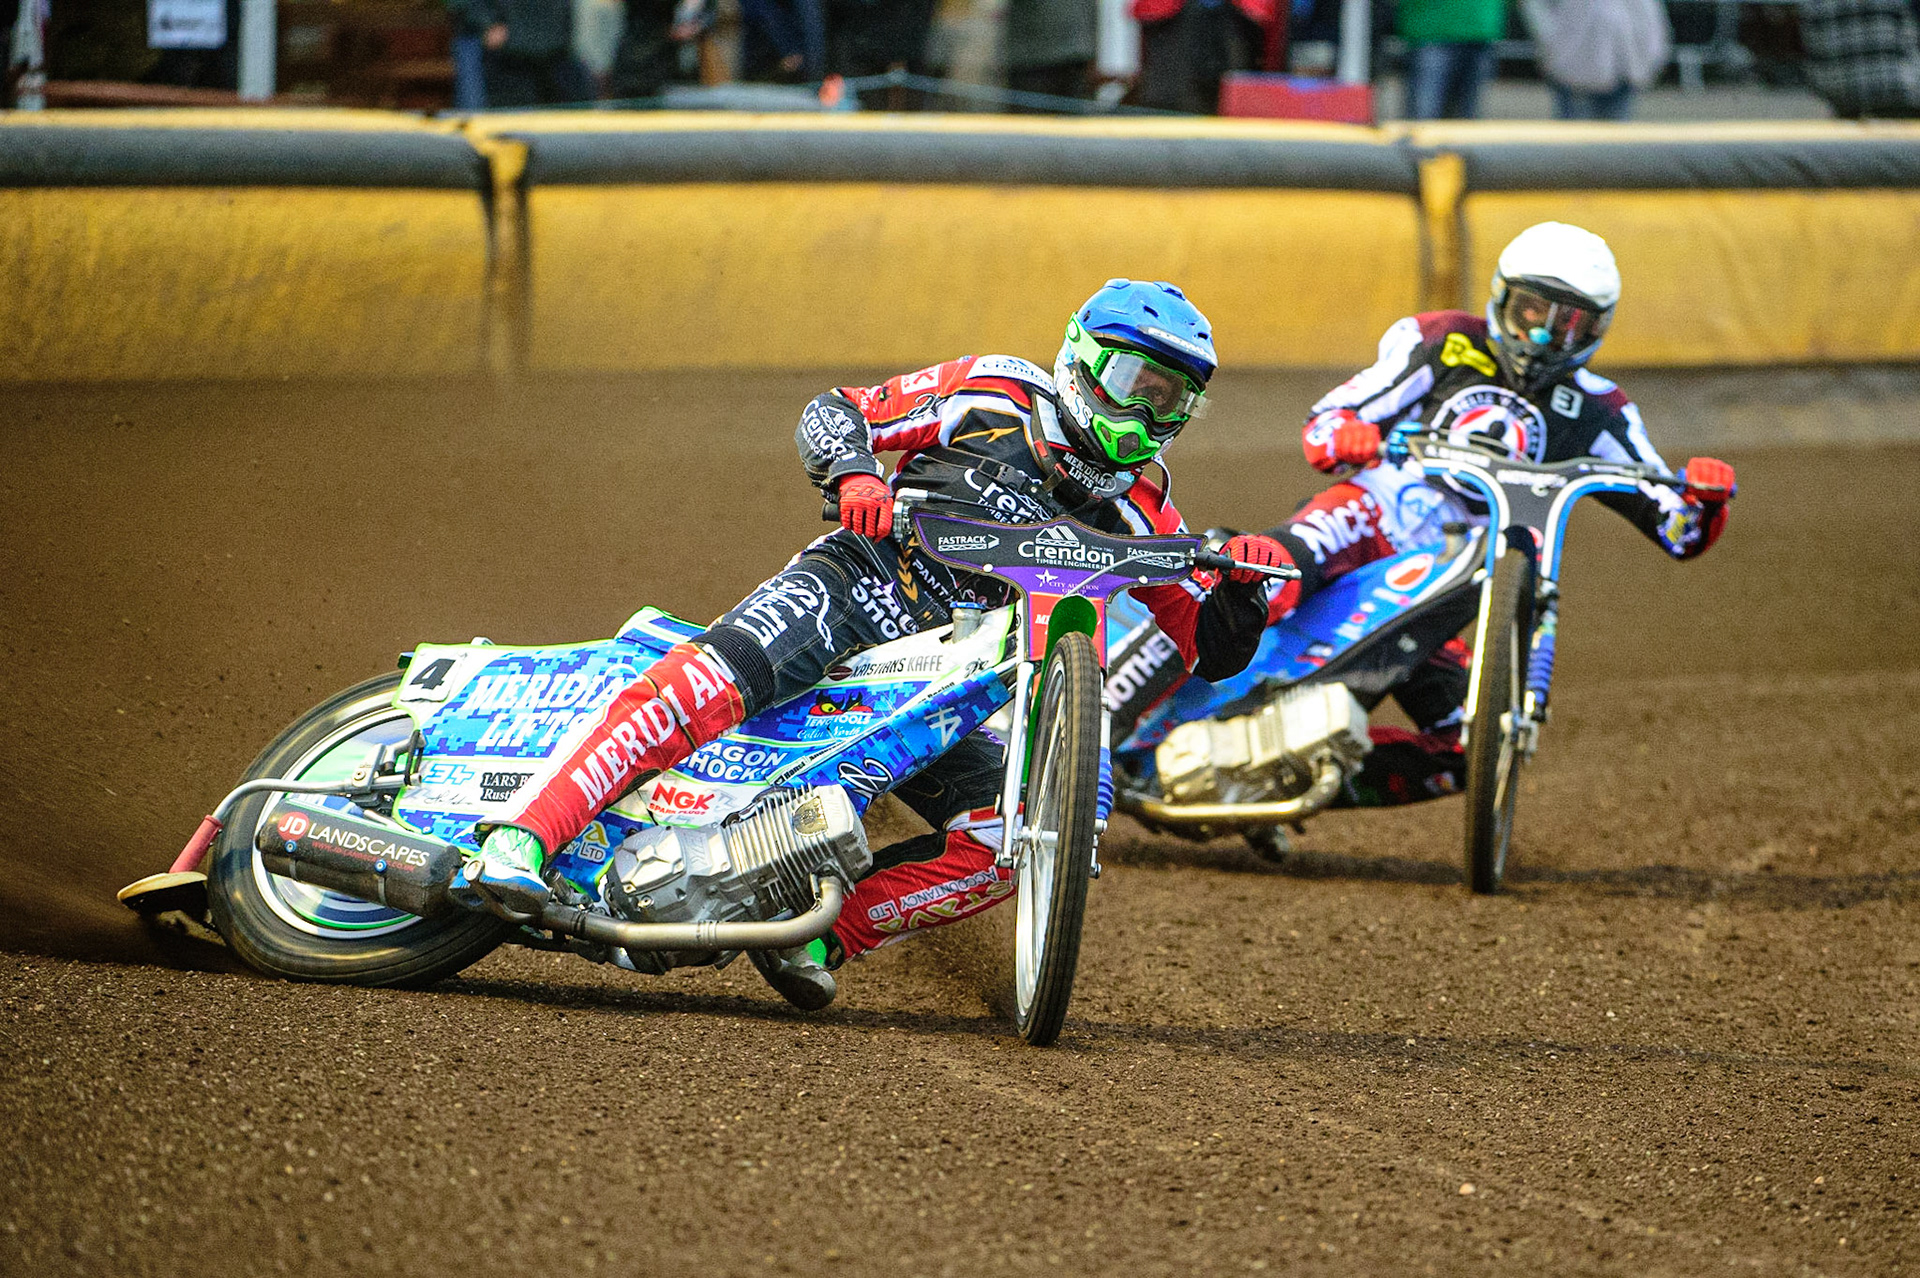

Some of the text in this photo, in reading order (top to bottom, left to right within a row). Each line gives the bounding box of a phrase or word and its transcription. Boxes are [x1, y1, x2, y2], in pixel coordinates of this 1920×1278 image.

[1062, 452, 1107, 486] MERIDIAN
[1068, 466, 1097, 493] LIFTS
[938, 535, 987, 545] FASTRACK
[1017, 540, 1115, 566] Crendon
[1035, 558, 1063, 566] TIMBER
[1067, 583, 1099, 591] AUTION
[734, 581, 820, 649] LIFTS
[851, 583, 901, 640] SHO
[410, 658, 457, 690] 4
[907, 655, 944, 672] KAFFE
[461, 673, 626, 711] MERIDIA
[570, 643, 736, 811] MERIDIAN
[833, 714, 872, 725] TOOLS
[679, 752, 771, 781] HOCK
[700, 742, 788, 767] AGON
[420, 763, 476, 786] 34
[482, 773, 517, 787] LARS
[649, 803, 677, 814] SPARK
[650, 782, 716, 811] NGK
[279, 815, 430, 867] JD LANDSCAPES
[580, 841, 605, 861] LTD
[867, 898, 899, 920] LTD
